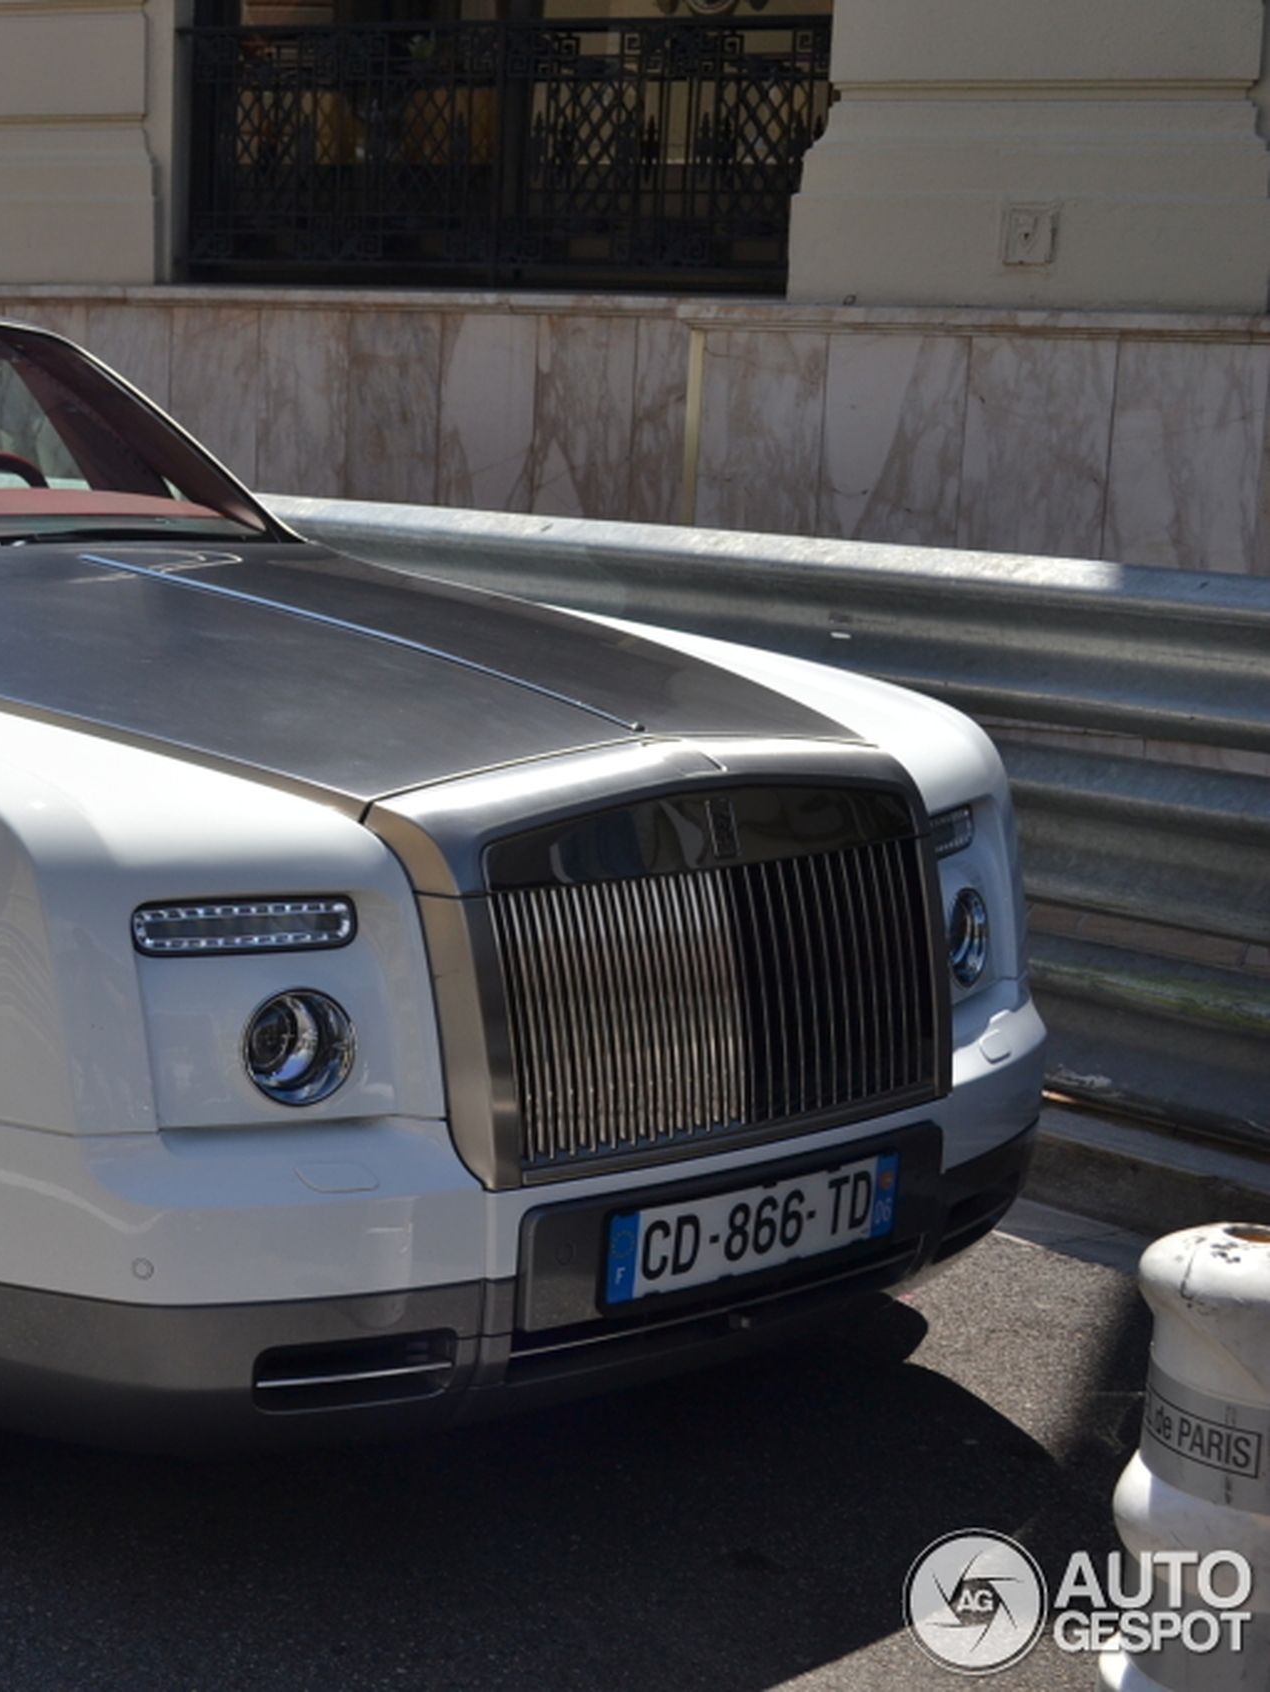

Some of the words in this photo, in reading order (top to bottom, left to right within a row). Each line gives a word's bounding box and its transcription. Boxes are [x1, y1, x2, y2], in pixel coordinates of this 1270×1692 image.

[640, 1169, 873, 1281] CD-866-TD
[614, 1266, 626, 1285] F
[1156, 1405, 1173, 1441] de
[1177, 1416, 1252, 1469] PARIS
